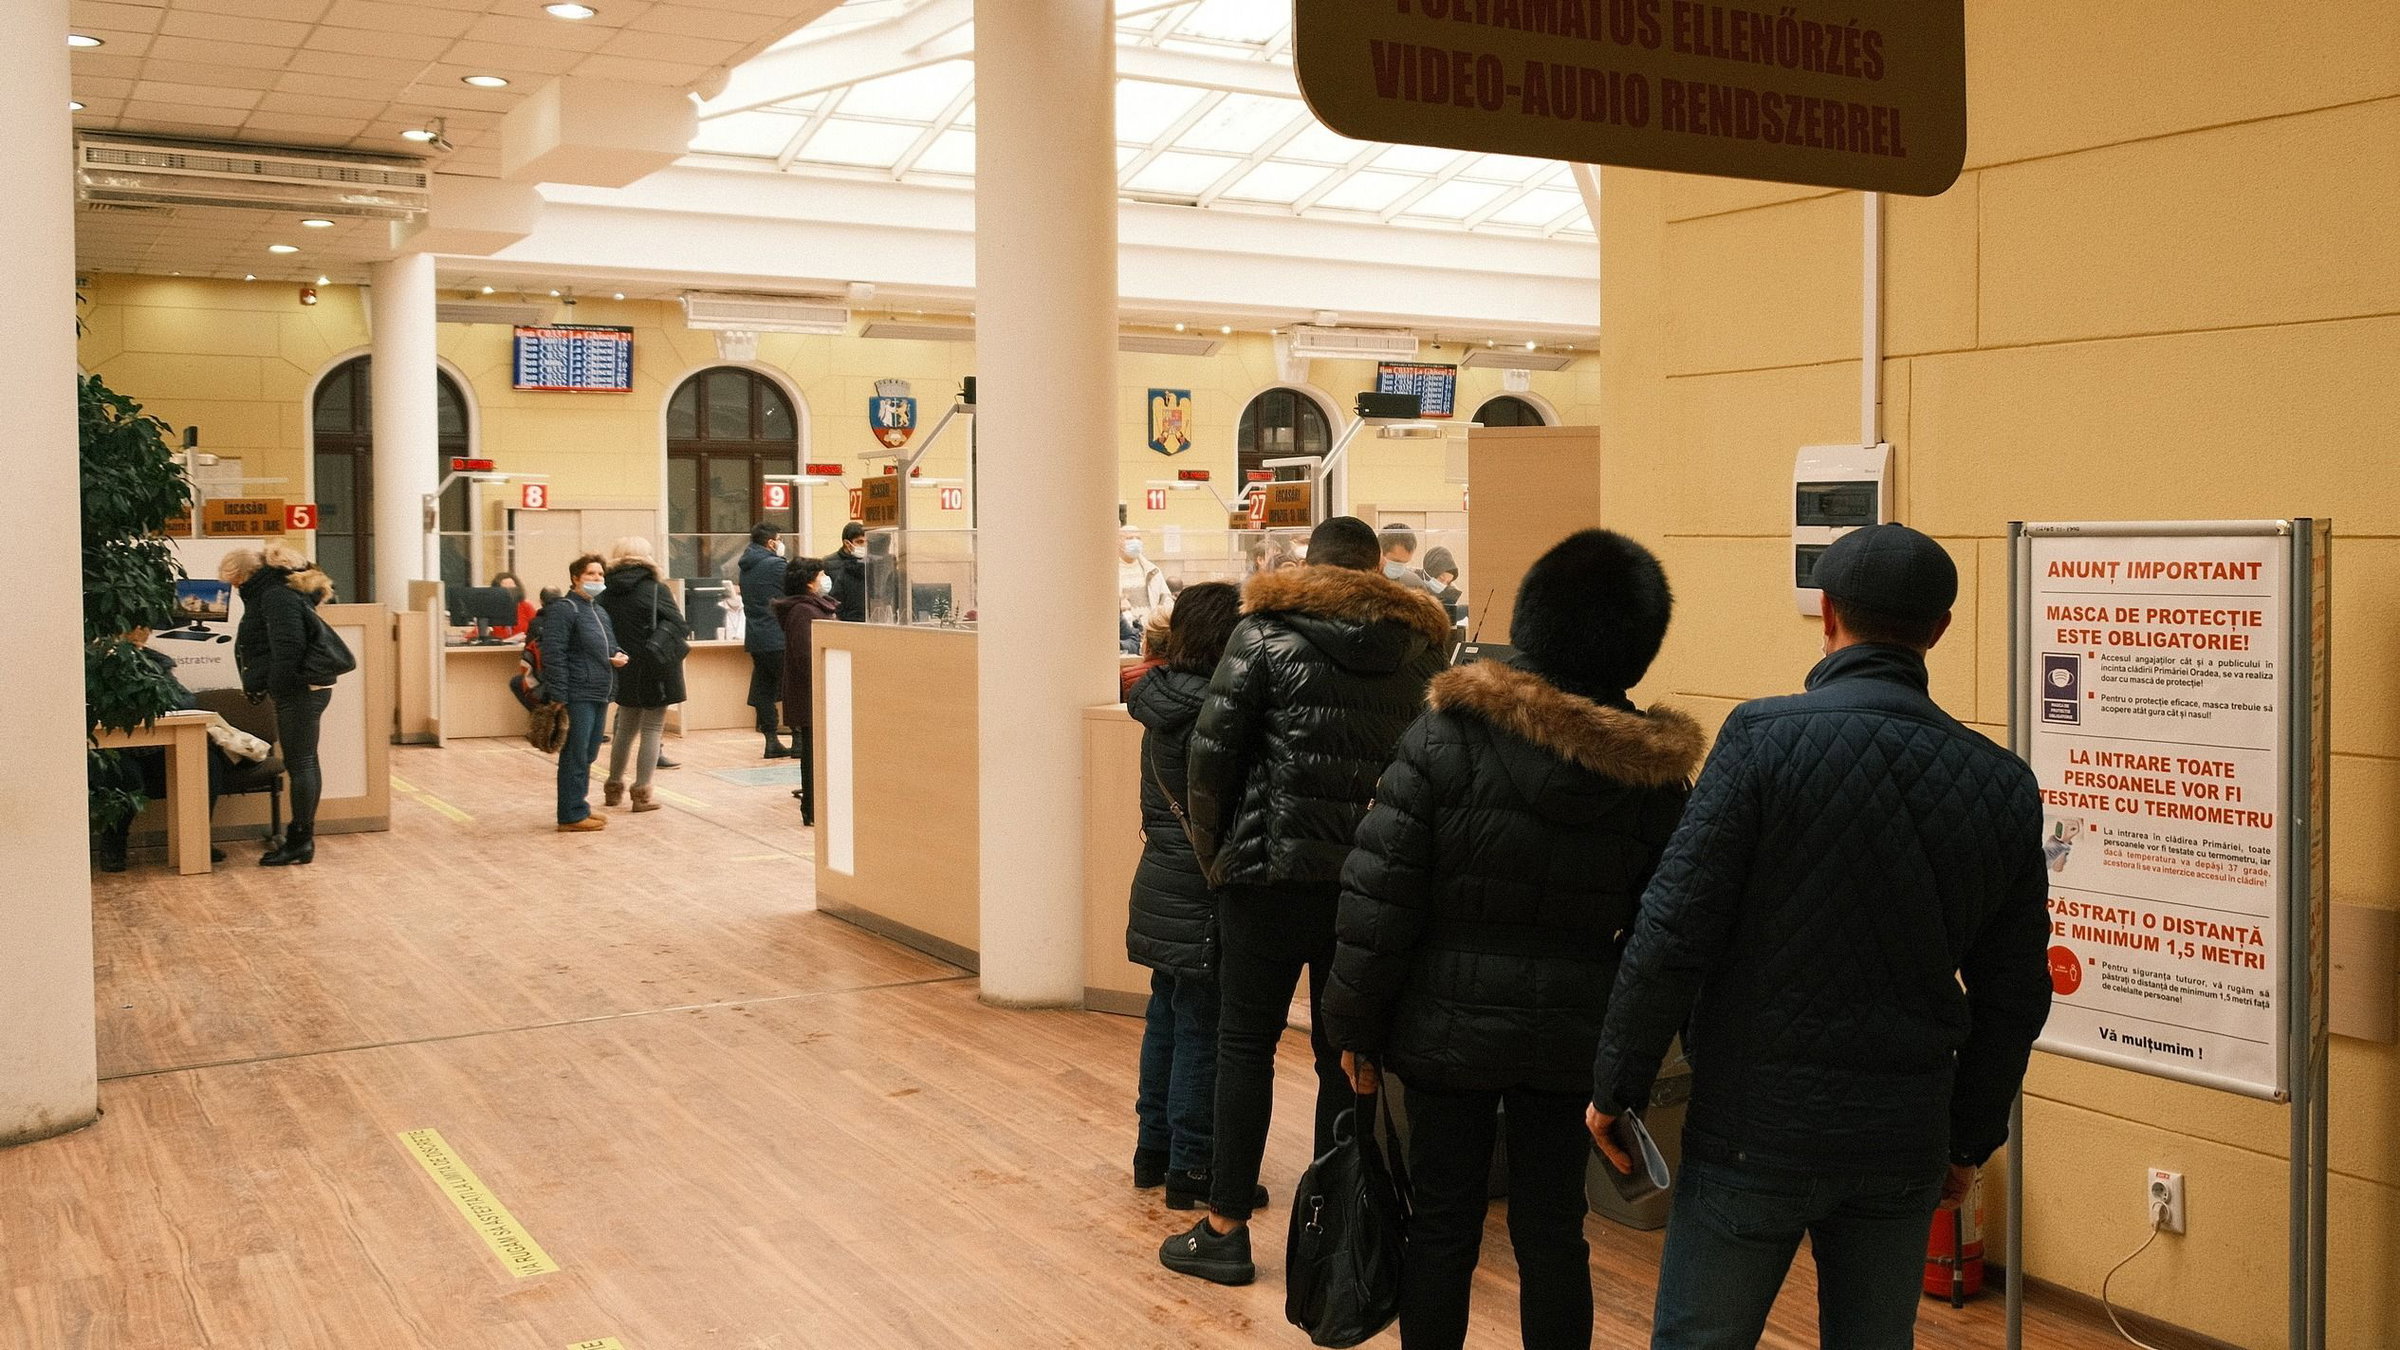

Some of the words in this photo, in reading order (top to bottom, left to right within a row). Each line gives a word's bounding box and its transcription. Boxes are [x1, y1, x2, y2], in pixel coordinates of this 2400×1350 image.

[1672, 0, 1885, 80] ELLENŐRZÉS
[1370, 39, 1649, 128] VIDEO-AUDIO
[1661, 76, 1907, 159] RENDSZERREL
[525, 485, 543, 508] 8
[769, 486, 785, 506] 9
[850, 489, 862, 519] 27
[942, 488, 962, 509] 10
[1149, 490, 1165, 509] 11
[1251, 493, 1267, 521] 27
[292, 506, 310, 528] 5
[2048, 561, 2121, 585] ANUNȚ
[2127, 562, 2262, 580] IMPORTANT
[2046, 606, 2109, 623] MASCA
[2115, 607, 2140, 624] DE
[2146, 608, 2262, 632] PROTECȚIE
[2057, 629, 2102, 645] ESTE
[2108, 630, 2249, 651] OBLIGATORIE!
[175, 655, 221, 665] istrative
[2101, 653, 2131, 662] Accesul
[2180, 657, 2192, 665] cât
[2218, 659, 2261, 668] publicului
[2101, 675, 2118, 683] doar
[2155, 677, 2165, 685] de
[2154, 666, 2189, 676] Primăriei
[2190, 668, 2221, 679] Oradea,
[2245, 672, 2273, 680] realiza
[2101, 694, 2126, 703] Pentru
[2170, 698, 2200, 709] eficace,
[2202, 701, 2229, 710] masca
[2231, 703, 2261, 711] trebuie
[2263, 704, 2273, 712] să
[2101, 705, 2131, 715] acopere
[2148, 708, 2165, 717] gura
[2188, 711, 2212, 720] nasul!
[2070, 749, 2090, 765] LA
[2096, 751, 2171, 773] INTRARE
[2177, 758, 2235, 778] TOATE
[2065, 770, 2176, 796] PERSOANELE
[2182, 781, 2219, 800] VOR
[2225, 786, 2241, 802] FI
[2039, 789, 2110, 811] TESTATE
[2115, 797, 2139, 814] CU
[2144, 800, 2273, 829] TERMOMETRU
[2104, 827, 2113, 836] La
[2117, 829, 2148, 840] intrarea
[2249, 845, 2271, 855] toate
[2104, 838, 2144, 850] persoanele
[2161, 843, 2167, 852] fi
[2168, 845, 2195, 856] testate
[2196, 850, 2206, 858] cu
[2208, 851, 2258, 865] termometru,
[2260, 857, 2271, 866] iar
[2127, 851, 2176, 865] temperatura
[2103, 859, 2135, 870] acestora
[2162, 865, 2195, 877] interzice
[2196, 871, 2227, 881] accesul
[2142, 913, 2156, 928] O
[2163, 915, 2264, 948] DISTANȚĂ
[2072, 924, 2159, 952] MINIMUM
[2167, 939, 2195, 960] 1,5
[2202, 944, 2265, 970] METRI
[2102, 961, 2128, 973] Pentru
[2102, 982, 2112, 990] de
[2112, 984, 2143, 996] celelalte
[2144, 990, 2182, 1004] persoane!
[2169, 984, 2179, 992] de
[2180, 986, 2218, 999] minimum
[2232, 995, 2253, 1006] metri
[2099, 1026, 2118, 1042] Vă
[2122, 1033, 2194, 1058] mulțumim
